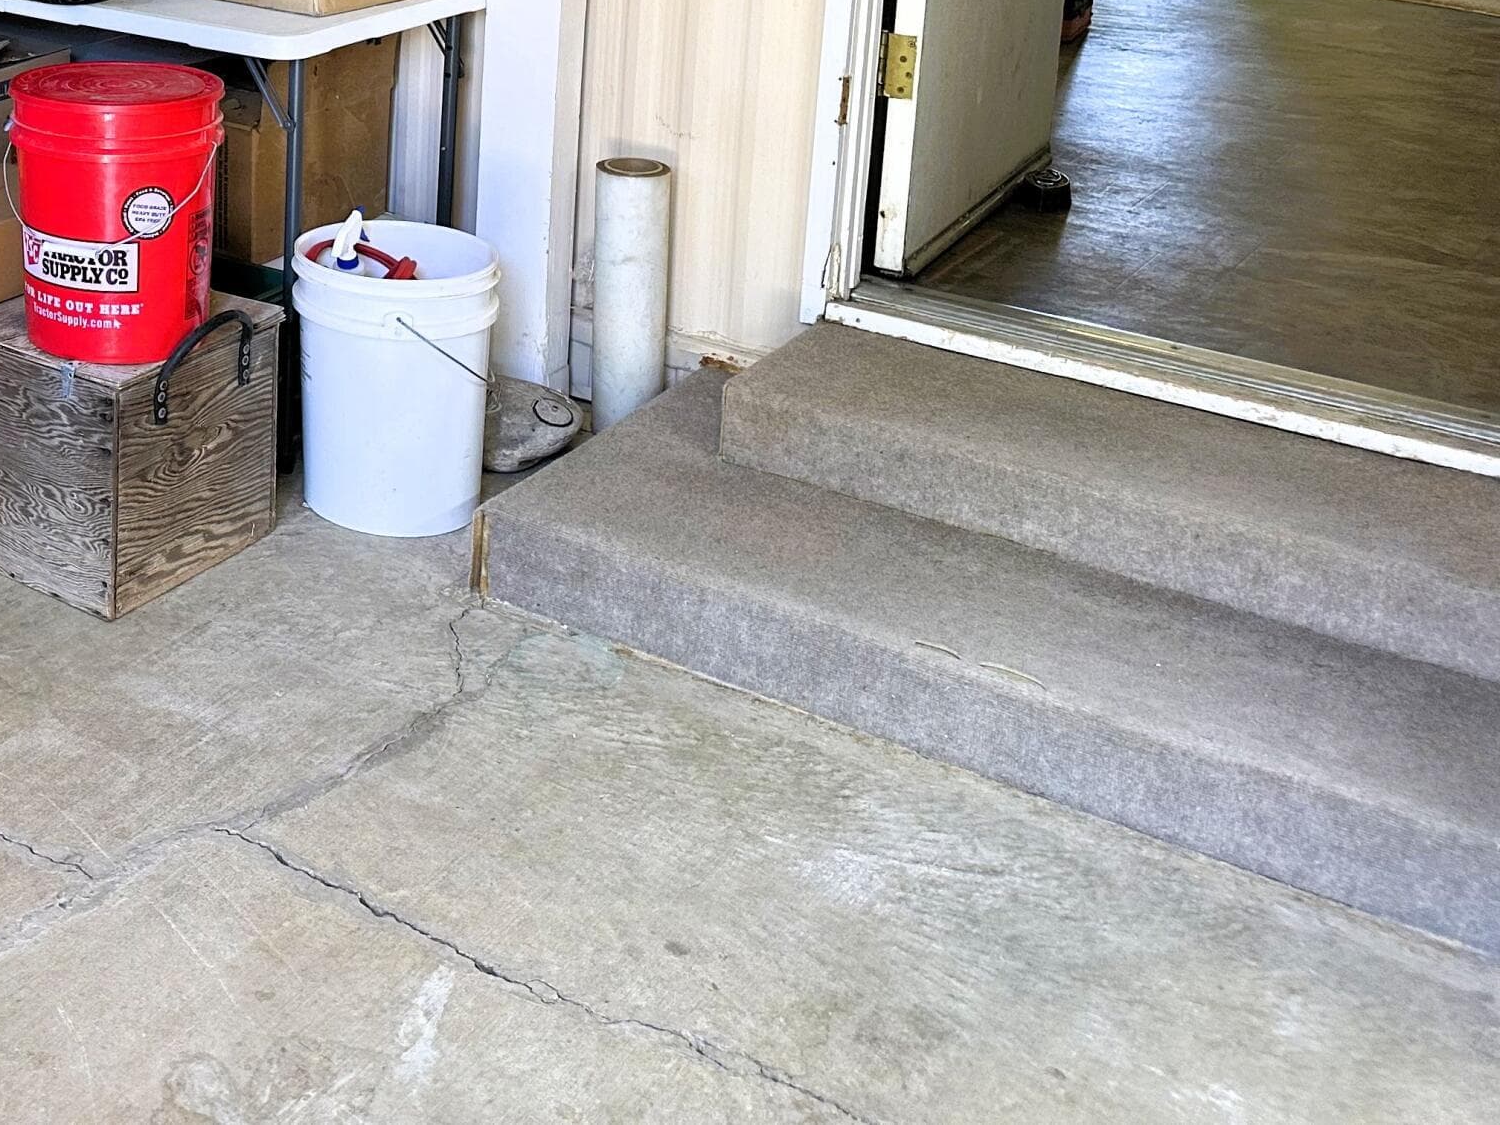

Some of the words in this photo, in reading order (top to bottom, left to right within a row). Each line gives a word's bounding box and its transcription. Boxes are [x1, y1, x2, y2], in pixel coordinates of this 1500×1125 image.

[42, 258, 102, 284] SUPPLY
[33, 302, 113, 329] TractorSupply.com
[38, 290, 61, 307] LIFE
[66, 300, 93, 314] OUT
[100, 303, 141, 315] HERE
